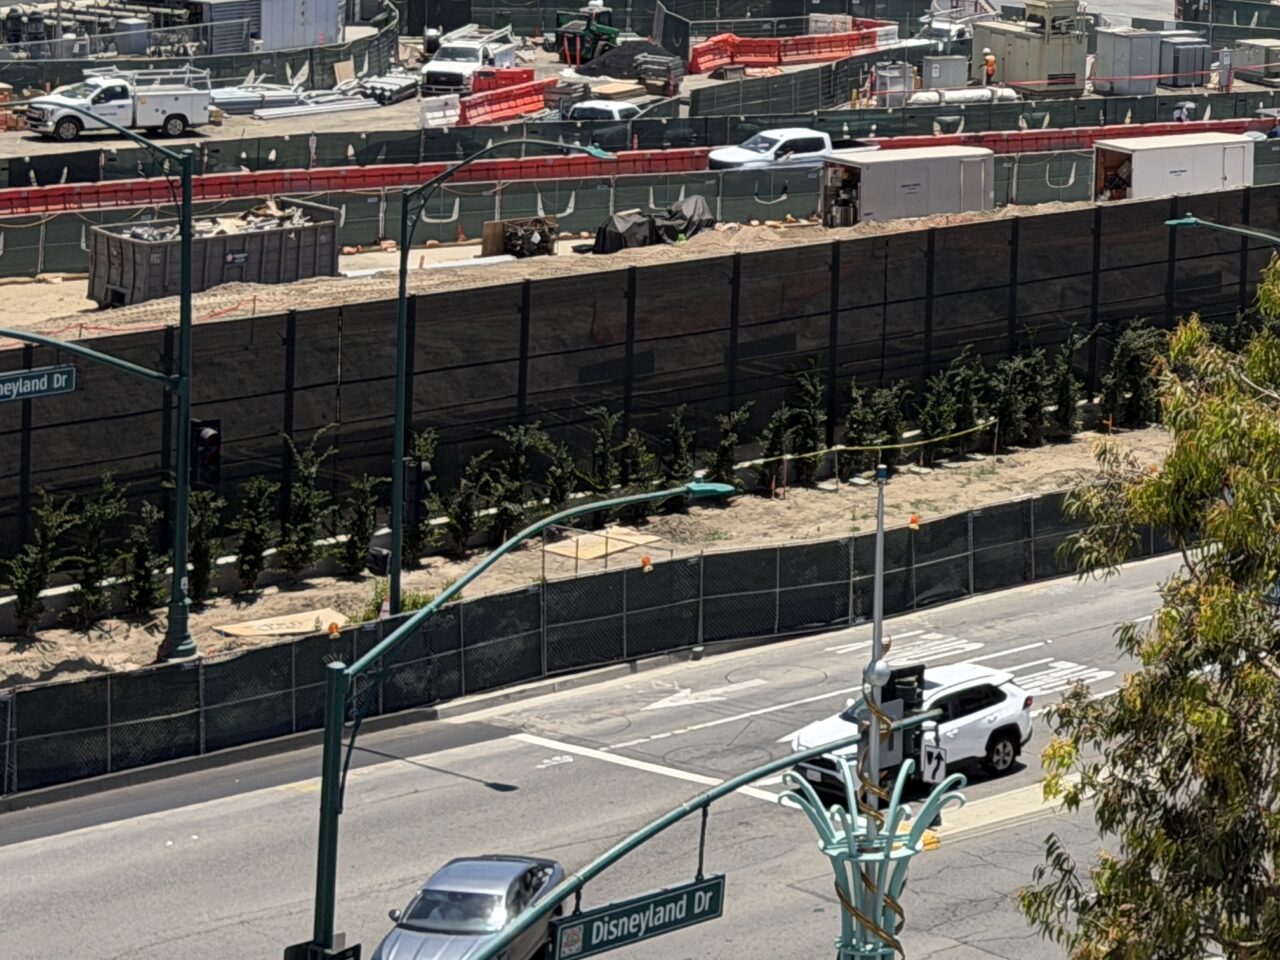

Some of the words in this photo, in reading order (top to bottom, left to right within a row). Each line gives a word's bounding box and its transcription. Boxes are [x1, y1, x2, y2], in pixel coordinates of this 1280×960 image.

[53, 373, 68, 389] Dr
[591, 893, 688, 946] Disneyland
[693, 891, 713, 914] Dr
